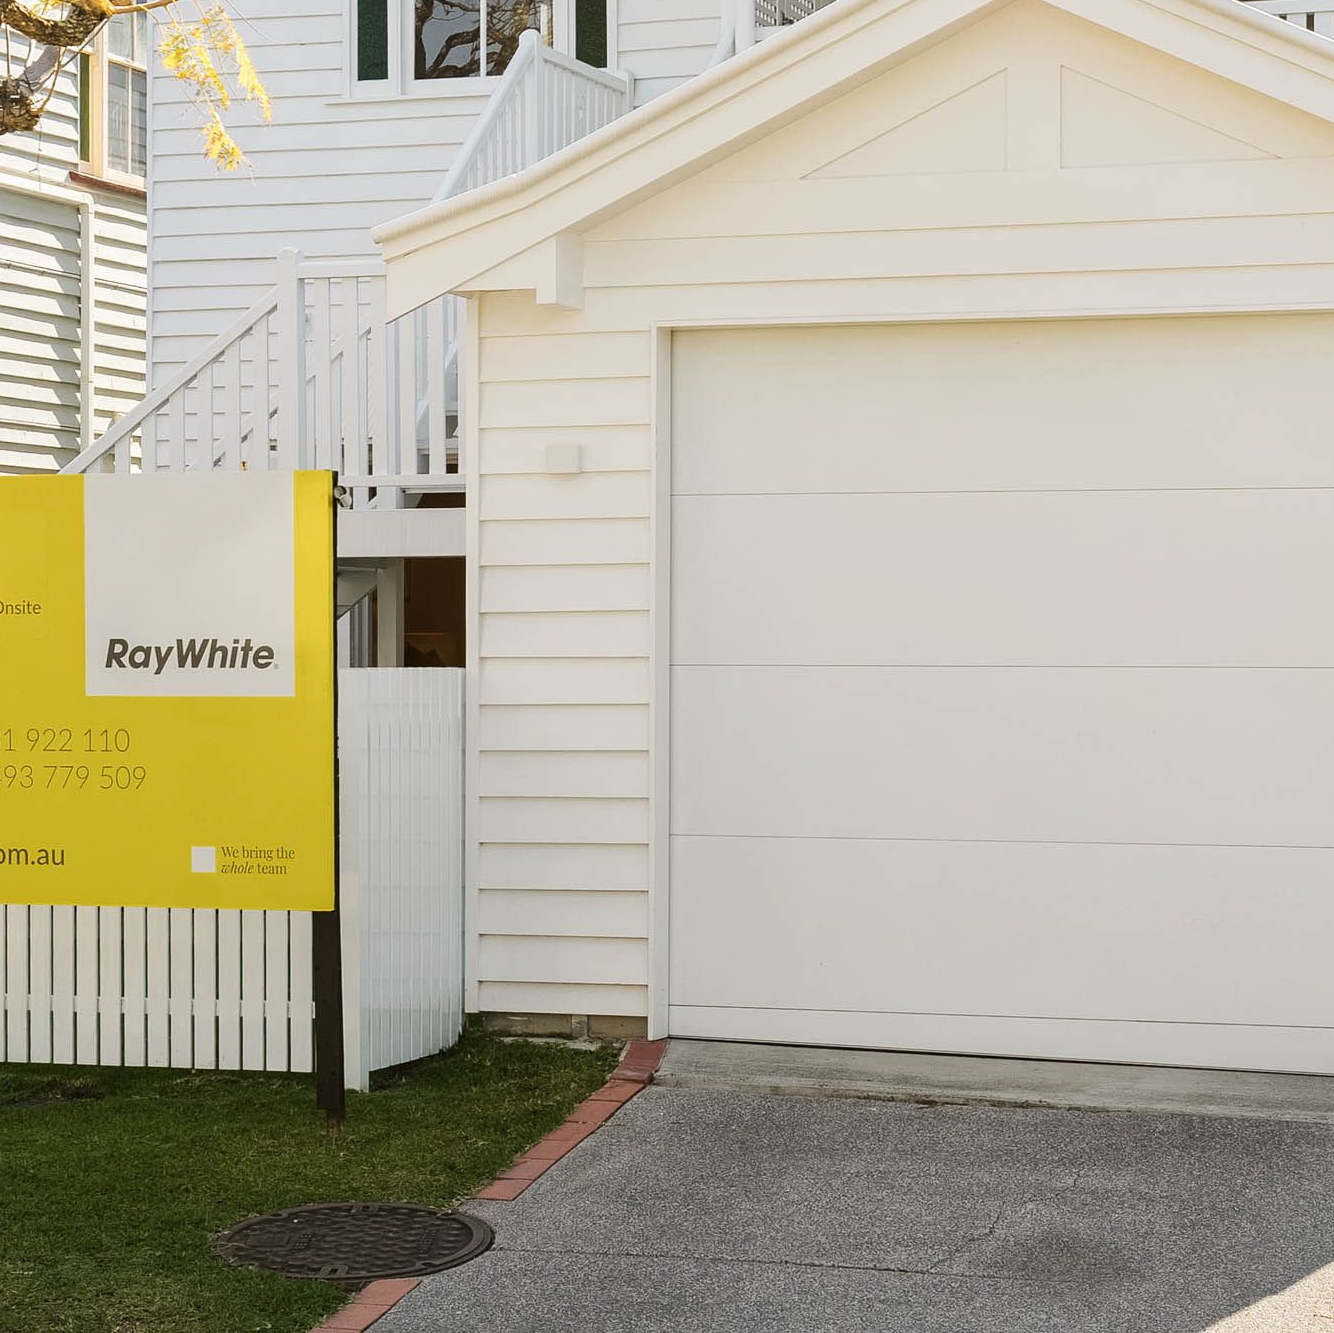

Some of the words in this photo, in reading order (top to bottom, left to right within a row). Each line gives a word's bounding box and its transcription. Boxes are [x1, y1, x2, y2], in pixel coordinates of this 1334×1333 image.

[25, 728, 73, 753] 922
[83, 728, 131, 753] 110
[43, 764, 90, 789] 779
[99, 765, 148, 790] 509
[221, 846, 240, 859] We
[242, 846, 274, 861] bring
[276, 846, 296, 860] the
[221, 861, 254, 874] whole
[257, 863, 287, 875] team
